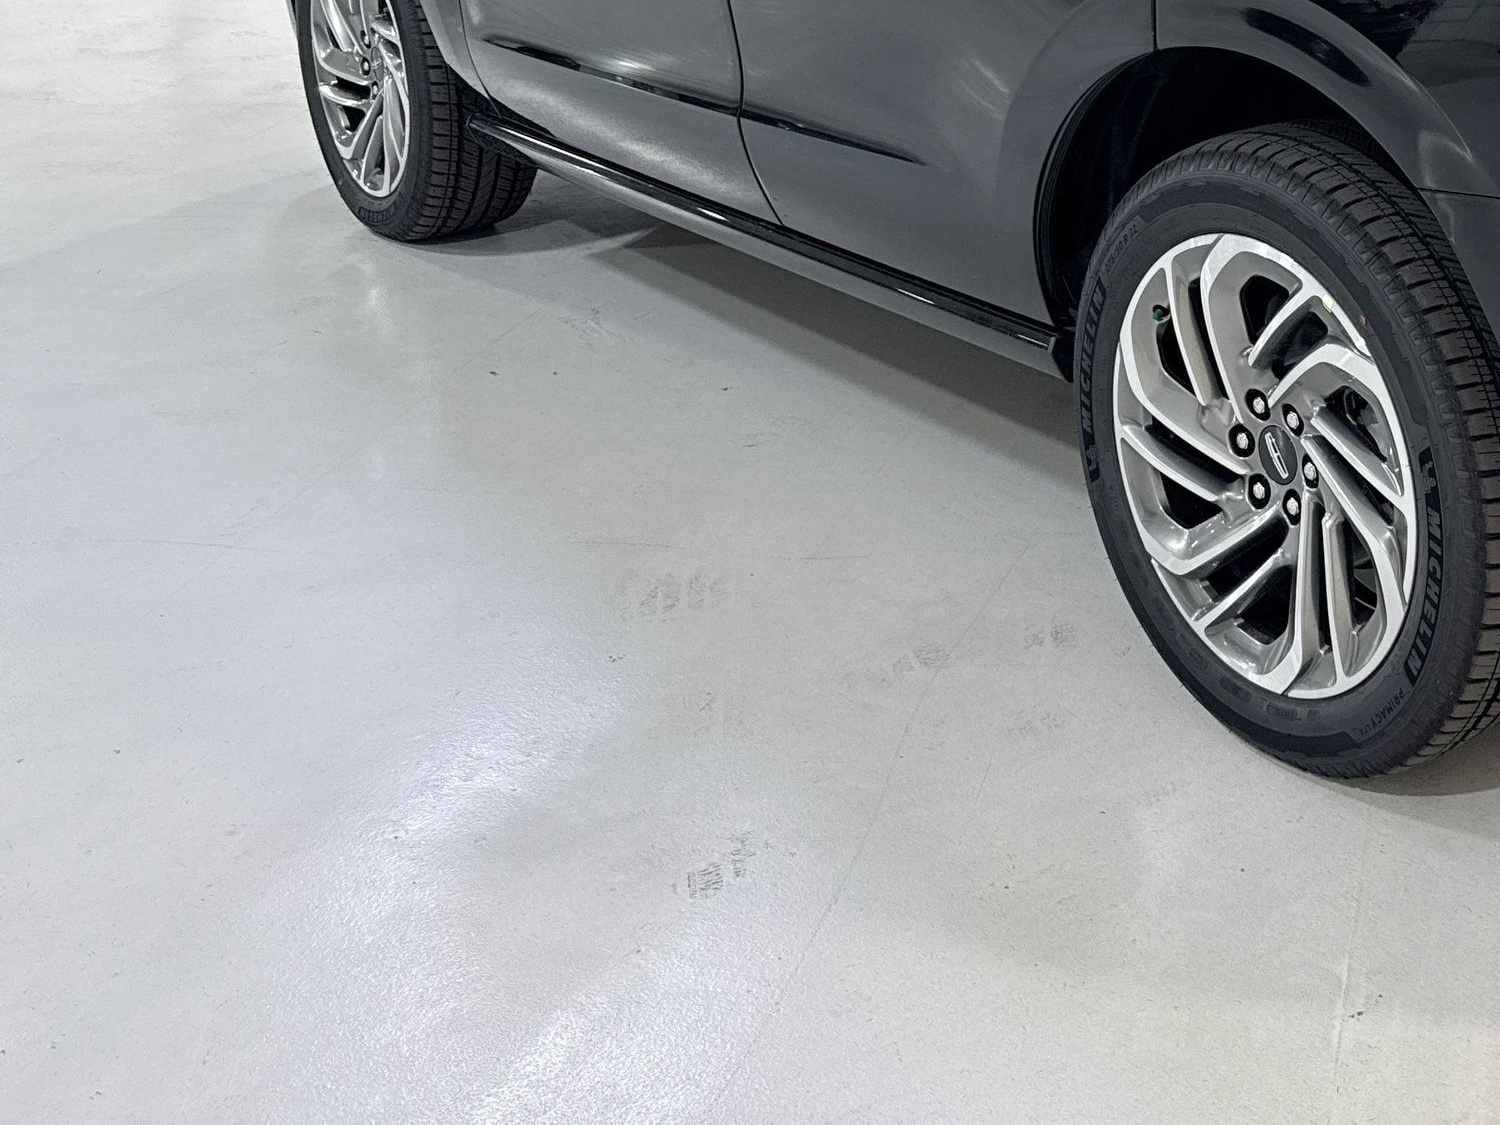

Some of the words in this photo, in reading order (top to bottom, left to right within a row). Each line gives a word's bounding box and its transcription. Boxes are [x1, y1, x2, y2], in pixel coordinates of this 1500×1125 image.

[1081, 283, 1104, 434] MICHELIN
[1406, 507, 1441, 672] MICHELIN
[1371, 687, 1405, 728] PRIMACY
